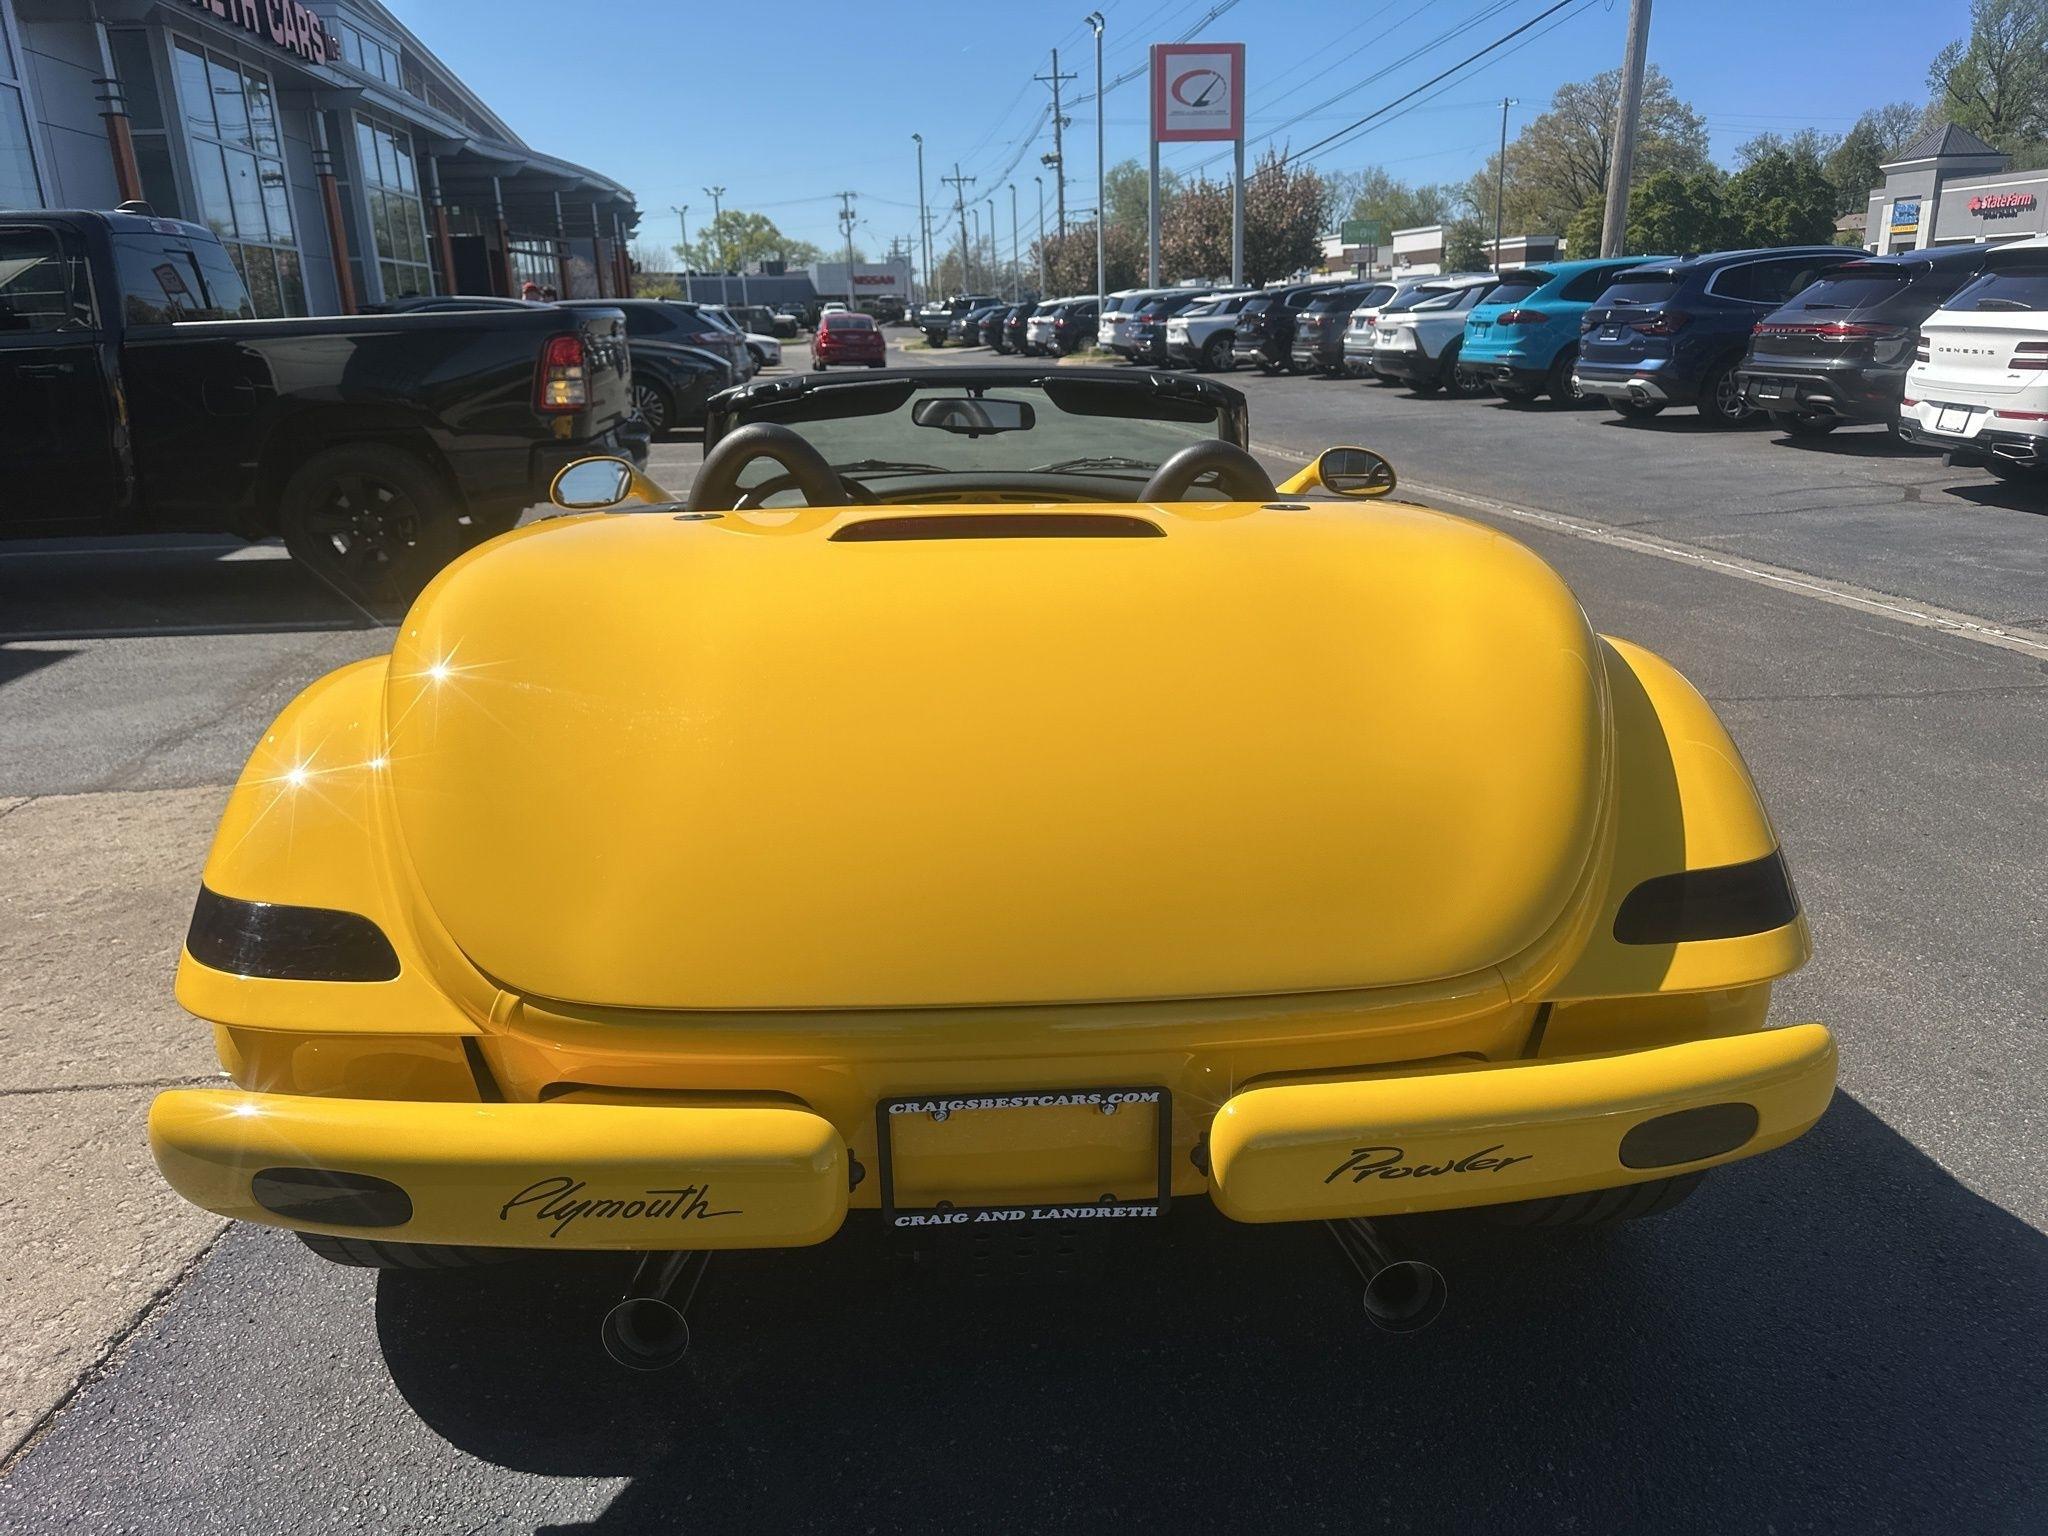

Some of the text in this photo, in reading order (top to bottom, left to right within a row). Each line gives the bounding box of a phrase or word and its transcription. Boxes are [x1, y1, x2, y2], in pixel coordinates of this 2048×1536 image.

[264, 0, 326, 66] CARS
[1938, 347, 1995, 356] GENESIS
[888, 1092, 1160, 1115] CRAIGSBESTCARS.COM
[1324, 1144, 1533, 1184] Prowler
[500, 1176, 743, 1239] Plymouth
[895, 1206, 1159, 1227] CRAIG AND LANDRETH
